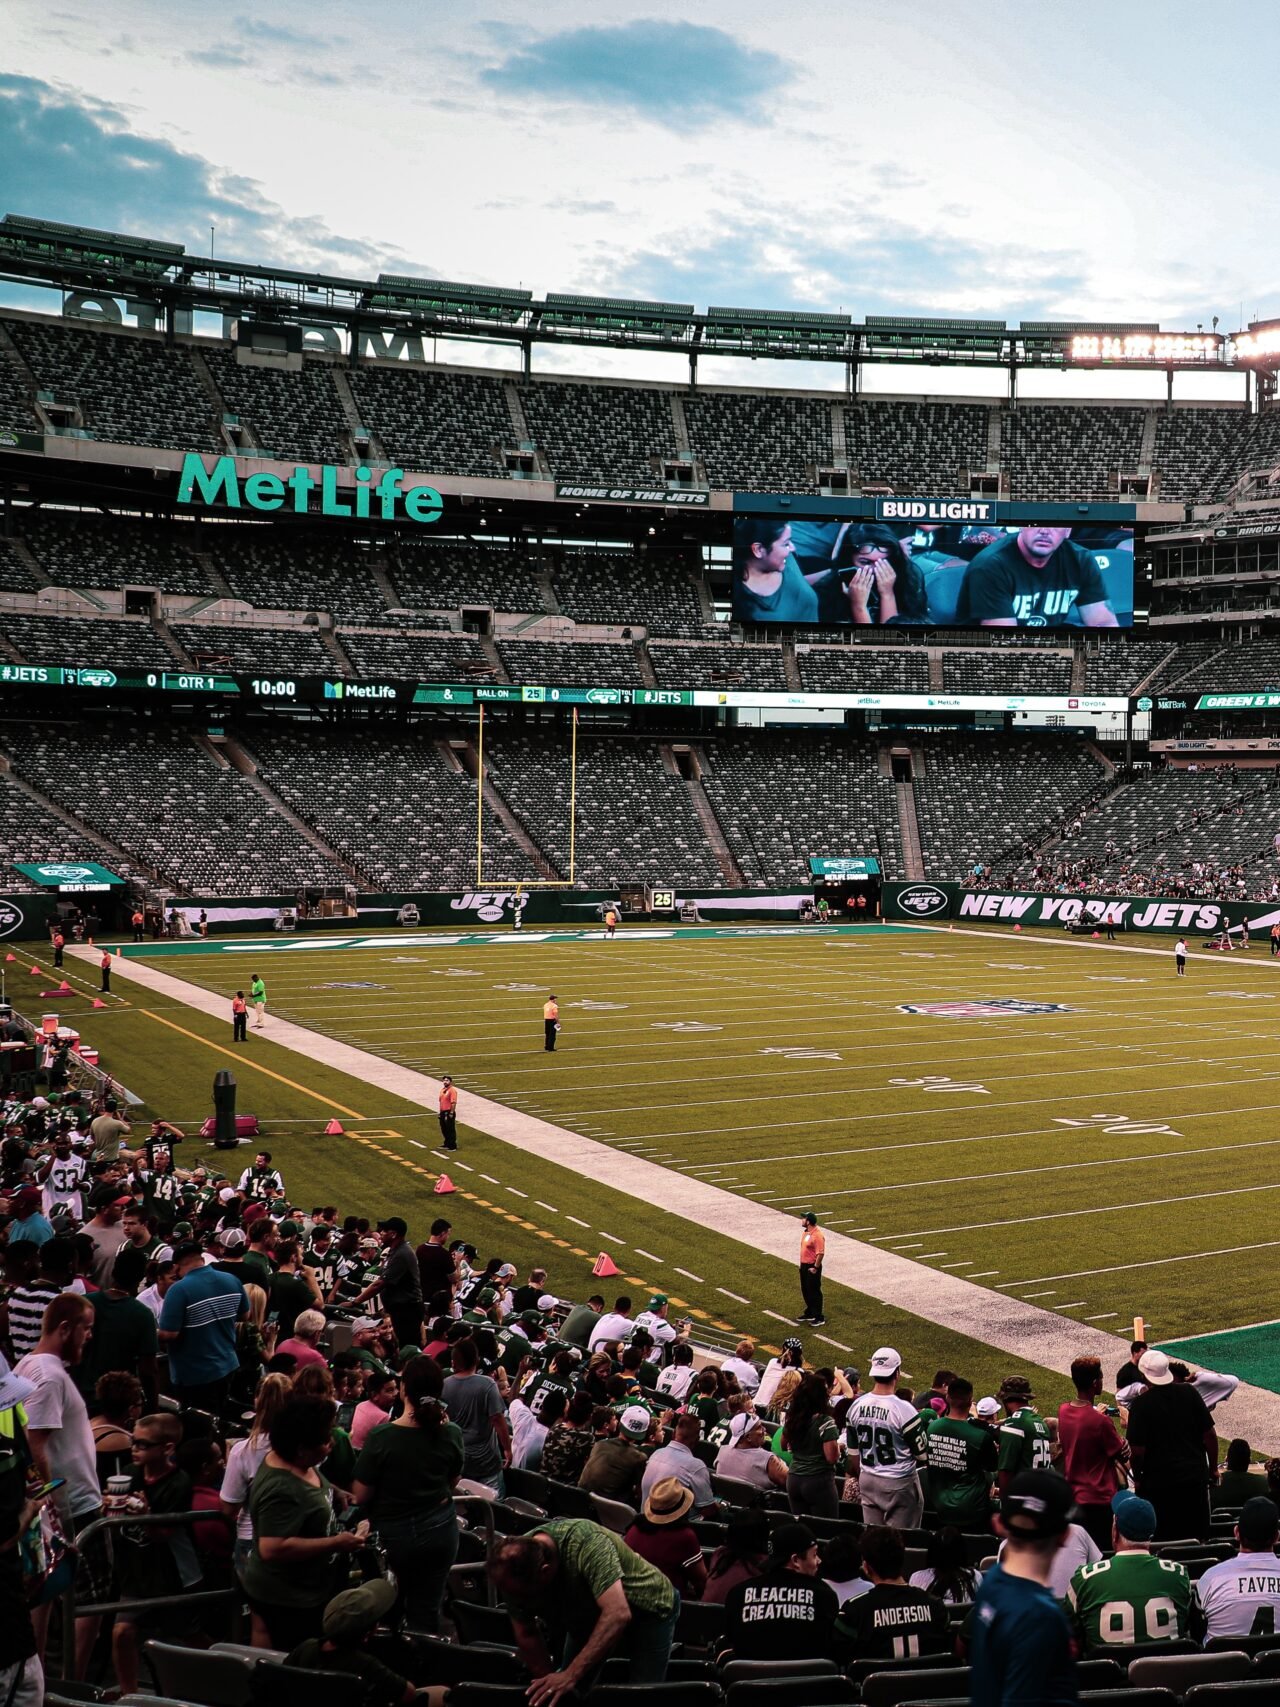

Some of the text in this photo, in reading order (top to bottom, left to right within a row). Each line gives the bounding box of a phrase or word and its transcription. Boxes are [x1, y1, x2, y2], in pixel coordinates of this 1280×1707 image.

[177, 453, 443, 522] MetLife
[560, 487, 707, 503] HOME OF THE JETS
[883, 502, 989, 519] BUD LIGHT
[1239, 526, 1263, 536] RING
[1264, 525, 1276, 533] OF
[1, 668, 48, 681] #JETS
[67, 675, 74, 684] 3
[147, 675, 157, 687] 0
[178, 677, 214, 689] QTR 1
[252, 681, 296, 696] 10:00
[346, 684, 396, 698] MetLife
[444, 689, 453, 699] &
[476, 689, 509, 698] BALL ON
[527, 690, 540, 699] 25
[551, 690, 559, 700] 0
[644, 692, 682, 704] #JETS
[1172, 699, 1186, 708] Bank
[1207, 696, 1253, 707] GREEN
[1255, 695, 1265, 706] &
[450, 892, 530, 909] JETS
[654, 894, 671, 906] 25
[904, 897, 941, 905] JETS
[960, 894, 1221, 929] NEW YORK JETS
[1051, 1114, 1171, 1135] 20
[55, 1169, 79, 1193] 33
[153, 1177, 173, 1200] 14
[543, 1379, 569, 1395] DECKER
[859, 1405, 890, 1421] MARTIN
[856, 1424, 897, 1466] 28
[915, 1430, 927, 1452] 28
[744, 1587, 814, 1604] BLEACHER
[742, 1603, 815, 1623] CREATURES
[874, 1605, 932, 1628] ANDERSON
[1100, 1596, 1179, 1644] 99
